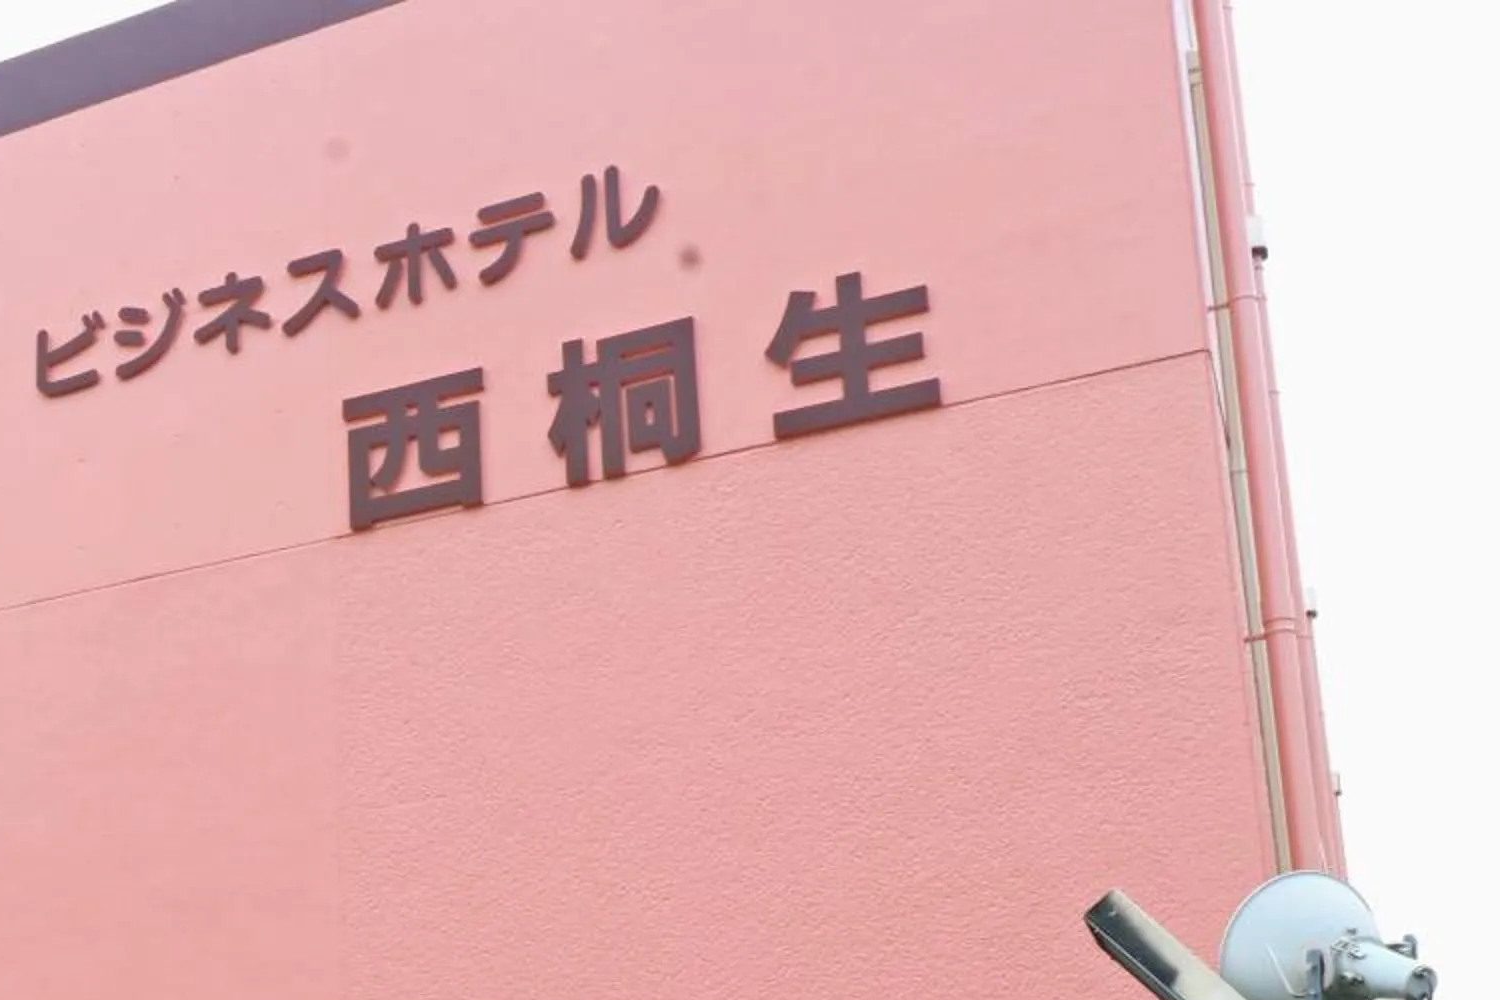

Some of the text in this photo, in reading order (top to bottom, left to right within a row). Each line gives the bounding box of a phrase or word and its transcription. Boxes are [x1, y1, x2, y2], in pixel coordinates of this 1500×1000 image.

[36, 165, 661, 400] ビジネスホテル
[342, 271, 942, 531] 西桐生
